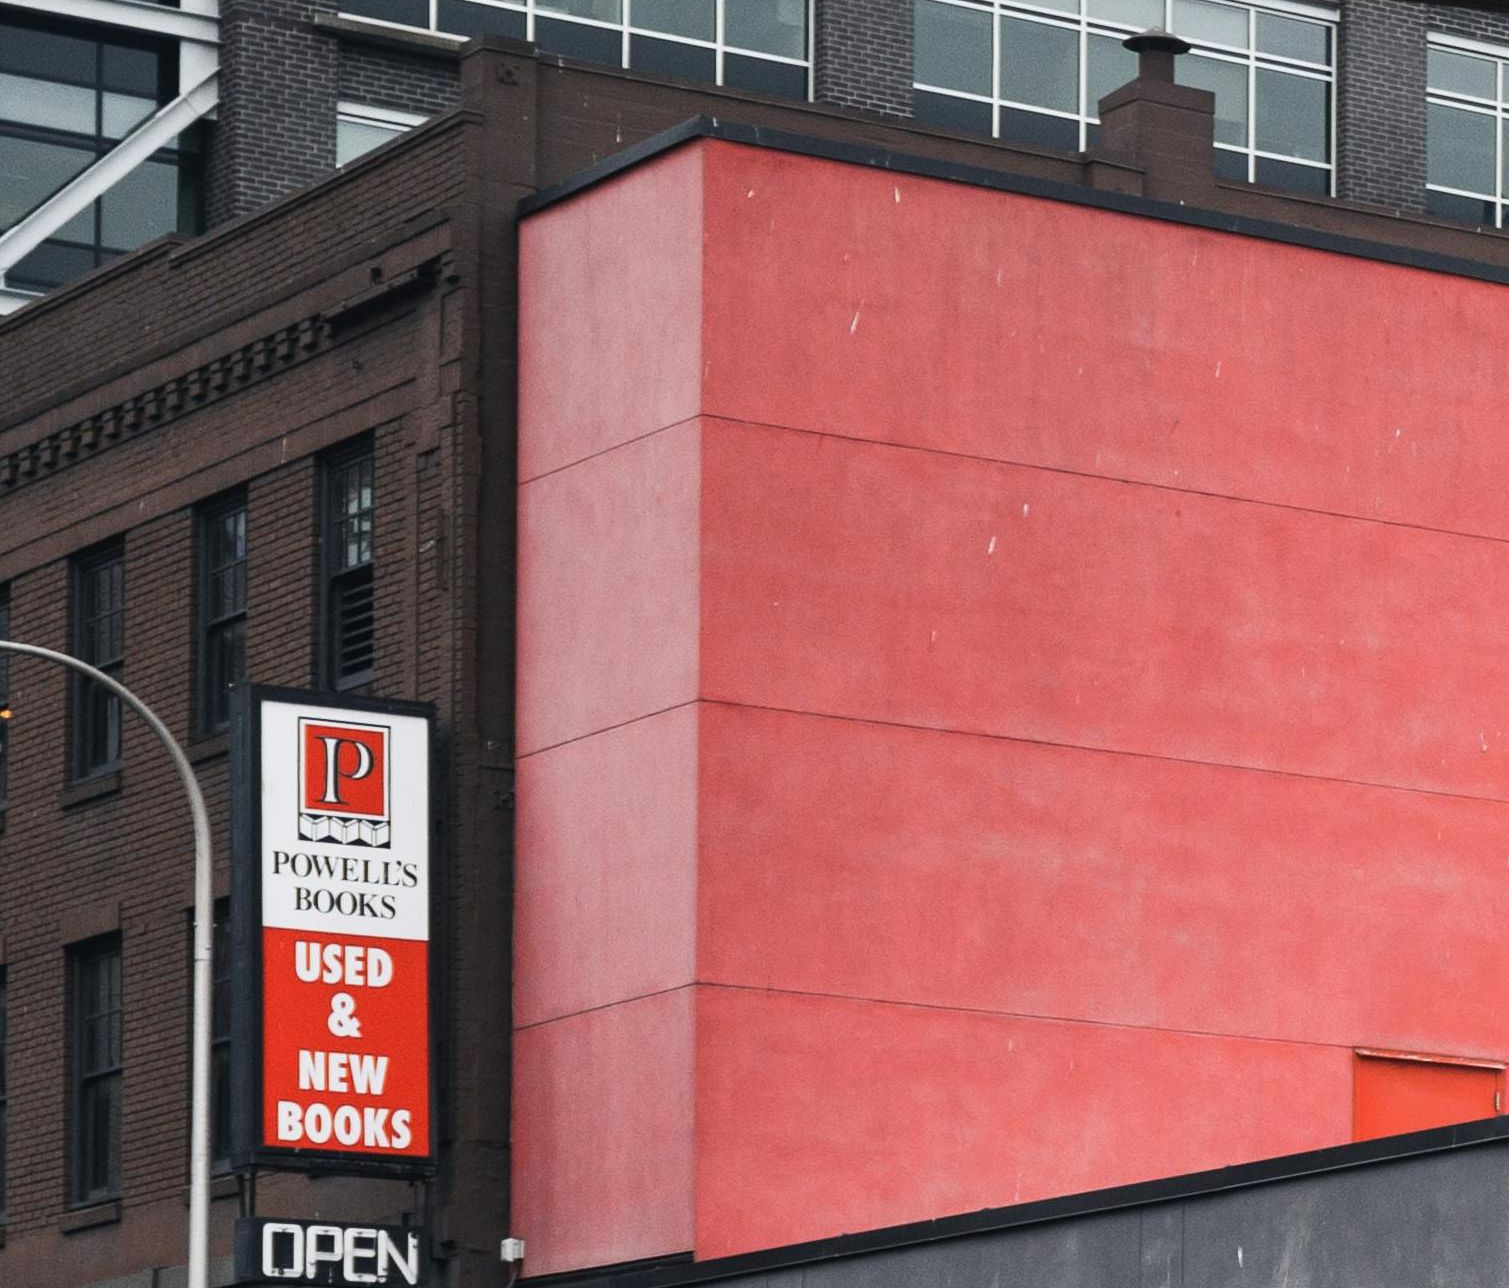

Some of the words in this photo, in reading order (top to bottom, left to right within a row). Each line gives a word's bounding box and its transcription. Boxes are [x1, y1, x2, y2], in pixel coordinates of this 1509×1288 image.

[315, 734, 375, 805] P
[272, 849, 419, 889] POWELL'S
[293, 885, 397, 921] BOOKS
[294, 940, 394, 989] USED
[327, 992, 362, 1039] &
[298, 1048, 389, 1096] NEW
[276, 1101, 413, 1150] BOOKS
[262, 1222, 419, 1287] OPEN
